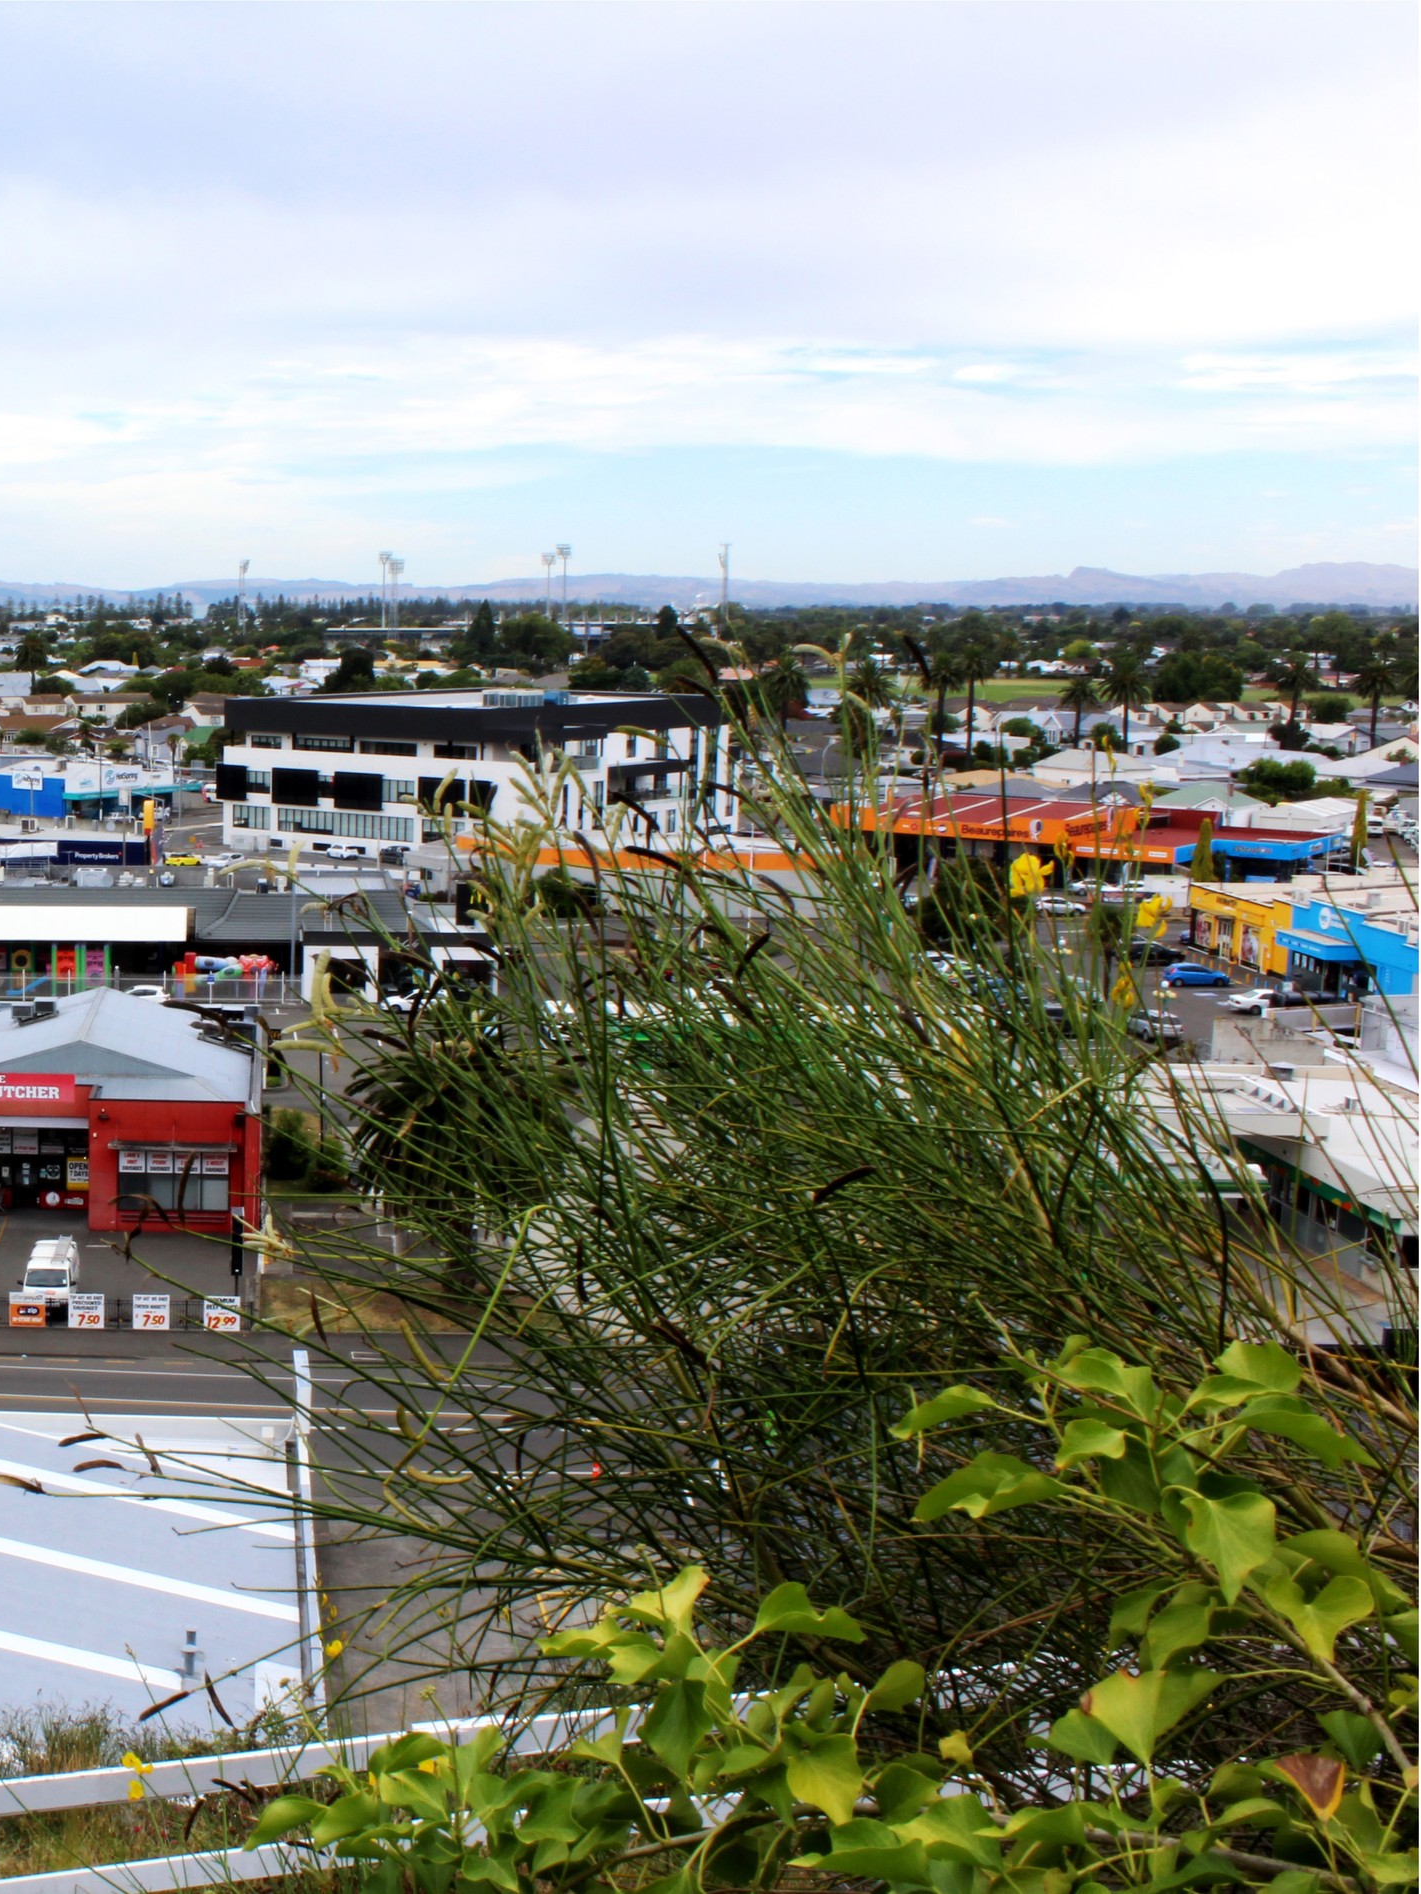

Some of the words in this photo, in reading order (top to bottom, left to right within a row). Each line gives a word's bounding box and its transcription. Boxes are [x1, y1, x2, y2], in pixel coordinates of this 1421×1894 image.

[74, 851, 98, 861] Property
[98, 852, 119, 860] Brokers
[68, 1162, 89, 1170] OPEN
